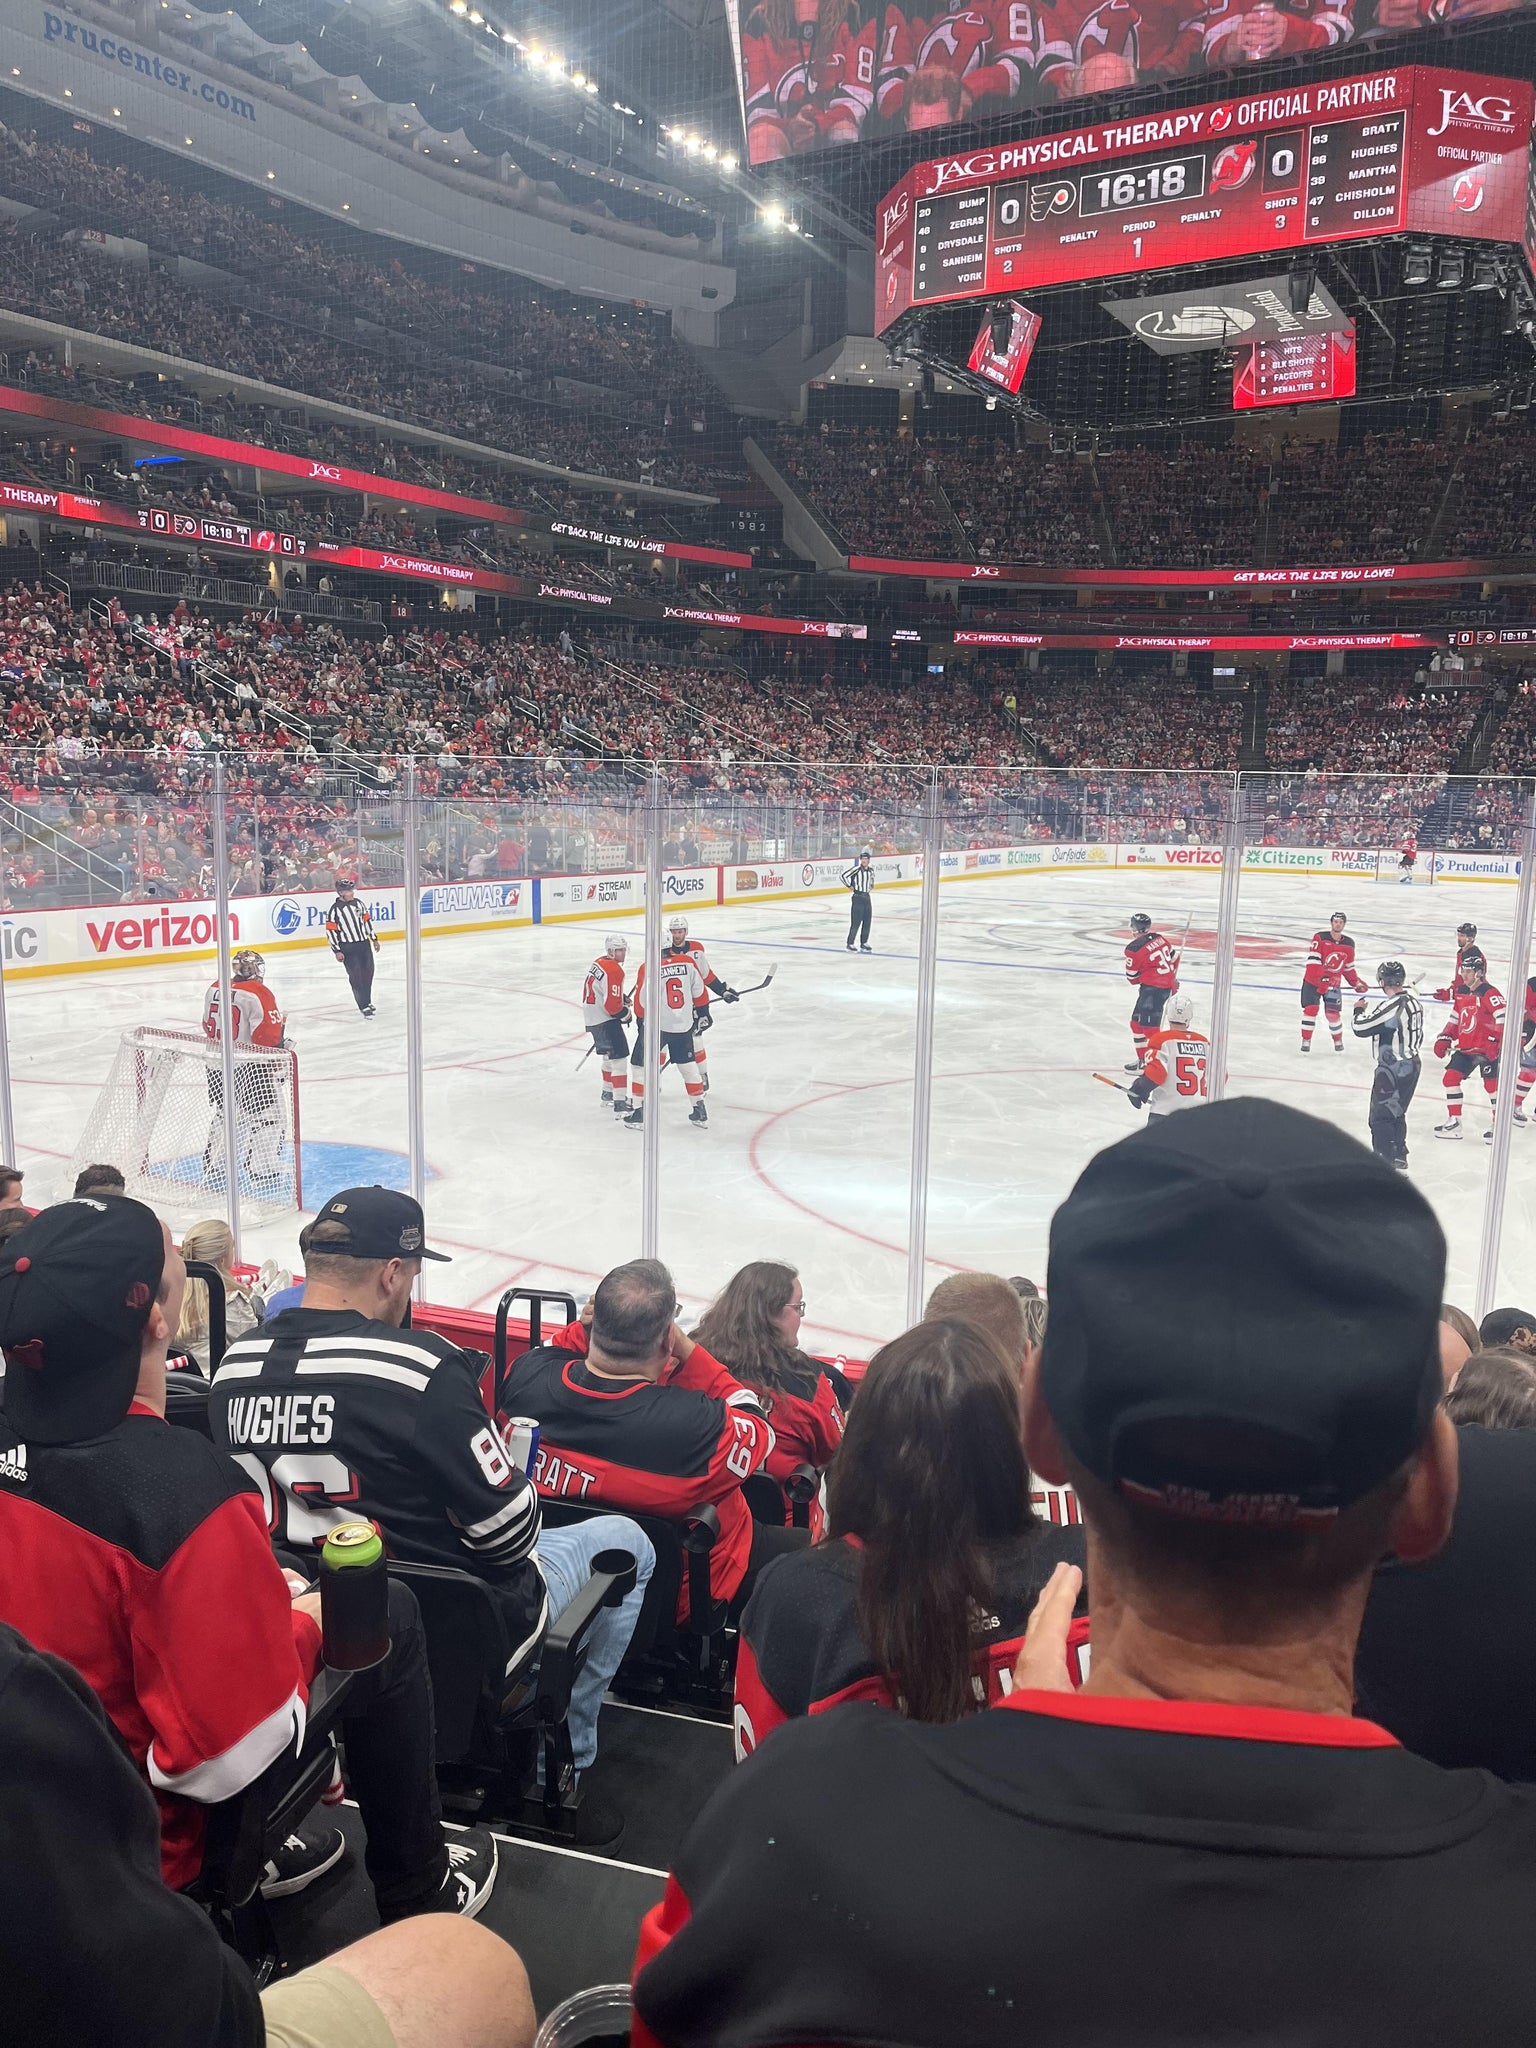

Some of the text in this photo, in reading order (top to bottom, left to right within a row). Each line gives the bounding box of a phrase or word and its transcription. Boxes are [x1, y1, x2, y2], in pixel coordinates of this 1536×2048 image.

[43, 11, 257, 122] prucenter.com
[857, 45, 874, 84] 8
[1427, 88, 1516, 136] JAG
[1362, 122, 1400, 137] BRATT
[1449, 119, 1515, 134] PHYSICAL THERAPY
[925, 76, 1396, 195] JAG PHYSICAL THERAPY OFFICIAL PARTNER
[1351, 143, 1398, 159] HUGHES
[1438, 145, 1503, 165] OFFICIAL PARTNER
[1271, 149, 1294, 176] 0
[1348, 164, 1397, 180] MANTHA
[1097, 164, 1187, 209] 16:18
[1265, 196, 1298, 209] SHOTS
[1308, 185, 1396, 206] 47 CHISHOLM
[918, 197, 985, 218] 20 BUMP
[1001, 199, 1020, 225] 0
[1353, 206, 1394, 219] DILLON
[880, 191, 909, 255] JAG
[949, 216, 984, 230] ZEGRAS
[1180, 209, 1222, 223] PENALTY
[1275, 215, 1286, 229] 3
[1122, 220, 1156, 233] PERIOD
[938, 234, 984, 251] DRYSDALE
[1059, 229, 1098, 244] PENALTY
[994, 243, 1022, 256] SHOTS
[1133, 237, 1142, 258] 1
[942, 253, 983, 267] SANHEIM
[1003, 259, 1013, 274] 2
[957, 271, 982, 283] YORK
[1245, 289, 1304, 332] Prudential
[1284, 346, 1303, 355] HITS
[1272, 360, 1287, 369] BLK
[1288, 357, 1315, 368] SHOTS
[1274, 370, 1313, 381] FACEOFFS
[1273, 382, 1314, 394] PENALTIES
[309, 462, 341, 480] JAG
[3, 486, 58, 507] THERAPY
[139, 517, 147, 527] 2
[155, 513, 165, 529] 0
[730, 521, 767, 532] 1982
[203, 524, 232, 539] 16:18
[551, 522, 665, 553] GET BACK THE LIFE YOU LOVE!
[282, 537, 292, 551] 0
[298, 546, 305, 555] 3
[380, 555, 474, 581] JAG PHYSICAL THERAPY
[971, 565, 1000, 577] JAG
[1233, 568, 1395, 581] GET BACK THE LIFE YOU LOVE!
[538, 583, 612, 605] JAG PHYSICAL THERAPY
[250, 611, 262, 622] 19
[397, 606, 407, 617] 18
[663, 606, 741, 624] JAG PHYSICAL THERAPY
[1350, 614, 1371, 625] WE
[801, 623, 825, 633] JAG
[953, 632, 1043, 644] JAG PHYSICAL THERAPY
[1115, 637, 1212, 648] JAG PHYSICAL THERAPY
[1289, 636, 1392, 648] JAG PHYSICAL THERAPY
[1461, 633, 1470, 643] 0
[1014, 851, 1041, 864] Citizens
[1052, 847, 1086, 862] Surfside
[1165, 847, 1223, 864] verizo
[1262, 850, 1323, 866] Citizens
[1341, 862, 1377, 870] HEALTH
[1448, 860, 1509, 873] Prudential
[598, 880, 632, 891] STREAM
[761, 873, 784, 888] Wawa
[433, 884, 504, 913] HALMAR
[598, 891, 618, 902] NOW
[86, 907, 240, 953] verizon
[1146, 938, 1166, 951] MANTHA
[611, 985, 620, 996] 91
[665, 978, 685, 1009] 6
[227, 1395, 336, 1445] HUGHES
[726, 1416, 757, 1479] 63
[533, 1448, 596, 1500] RATT
